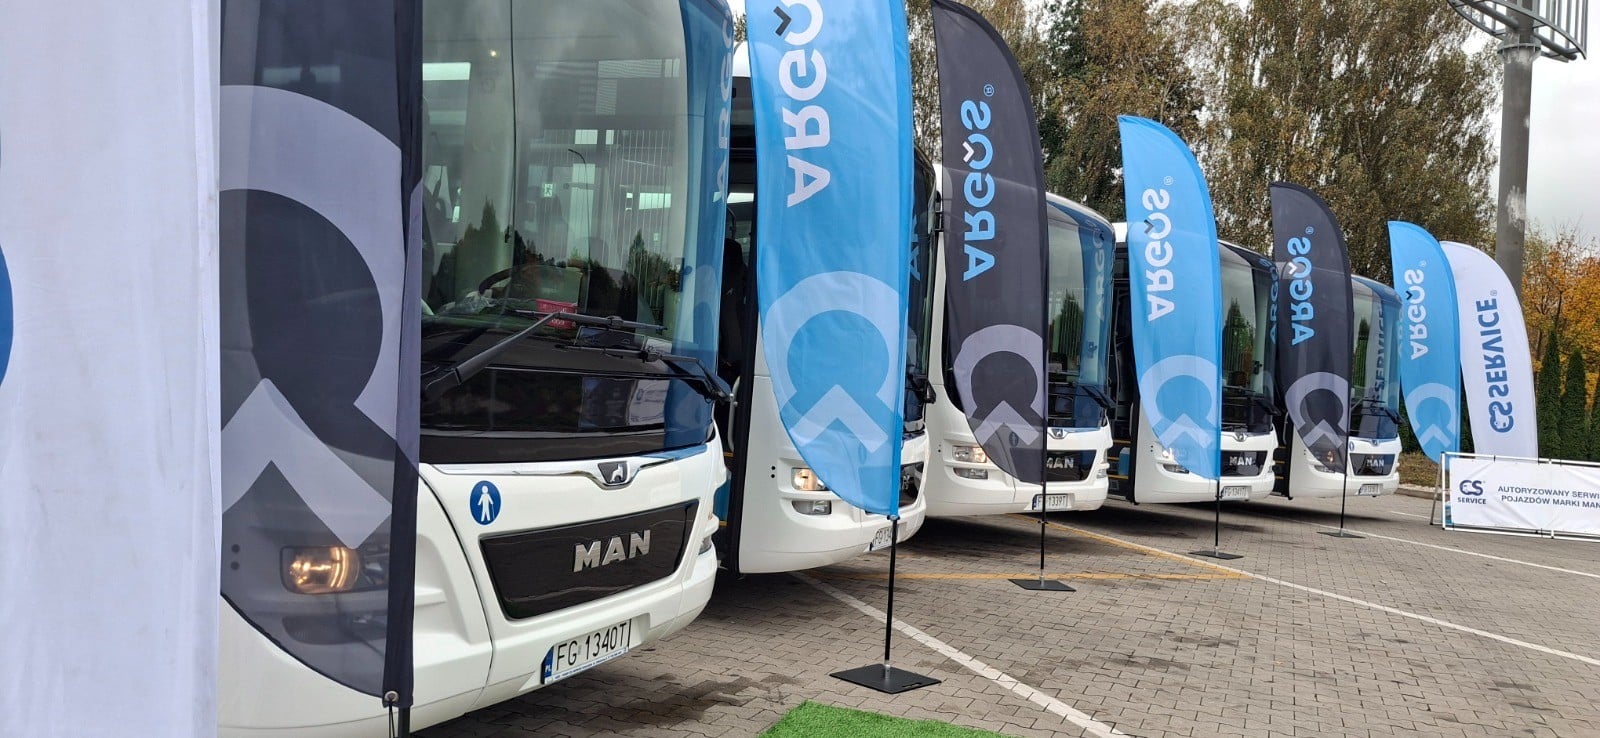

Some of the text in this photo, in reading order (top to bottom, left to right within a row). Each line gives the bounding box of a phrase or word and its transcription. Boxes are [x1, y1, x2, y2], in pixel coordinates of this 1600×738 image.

[1229, 456, 1252, 466] MAN
[1459, 479, 1484, 496] CS
[1498, 486, 1570, 497] AUTORYZOWANY
[1457, 496, 1487, 504] SERVICE
[1502, 495, 1550, 505] POJAZDÓW
[1553, 498, 1580, 507] MARKI
[572, 528, 651, 573] MAN
[556, 640, 578, 671] FG
[585, 622, 627, 660] 1340T
